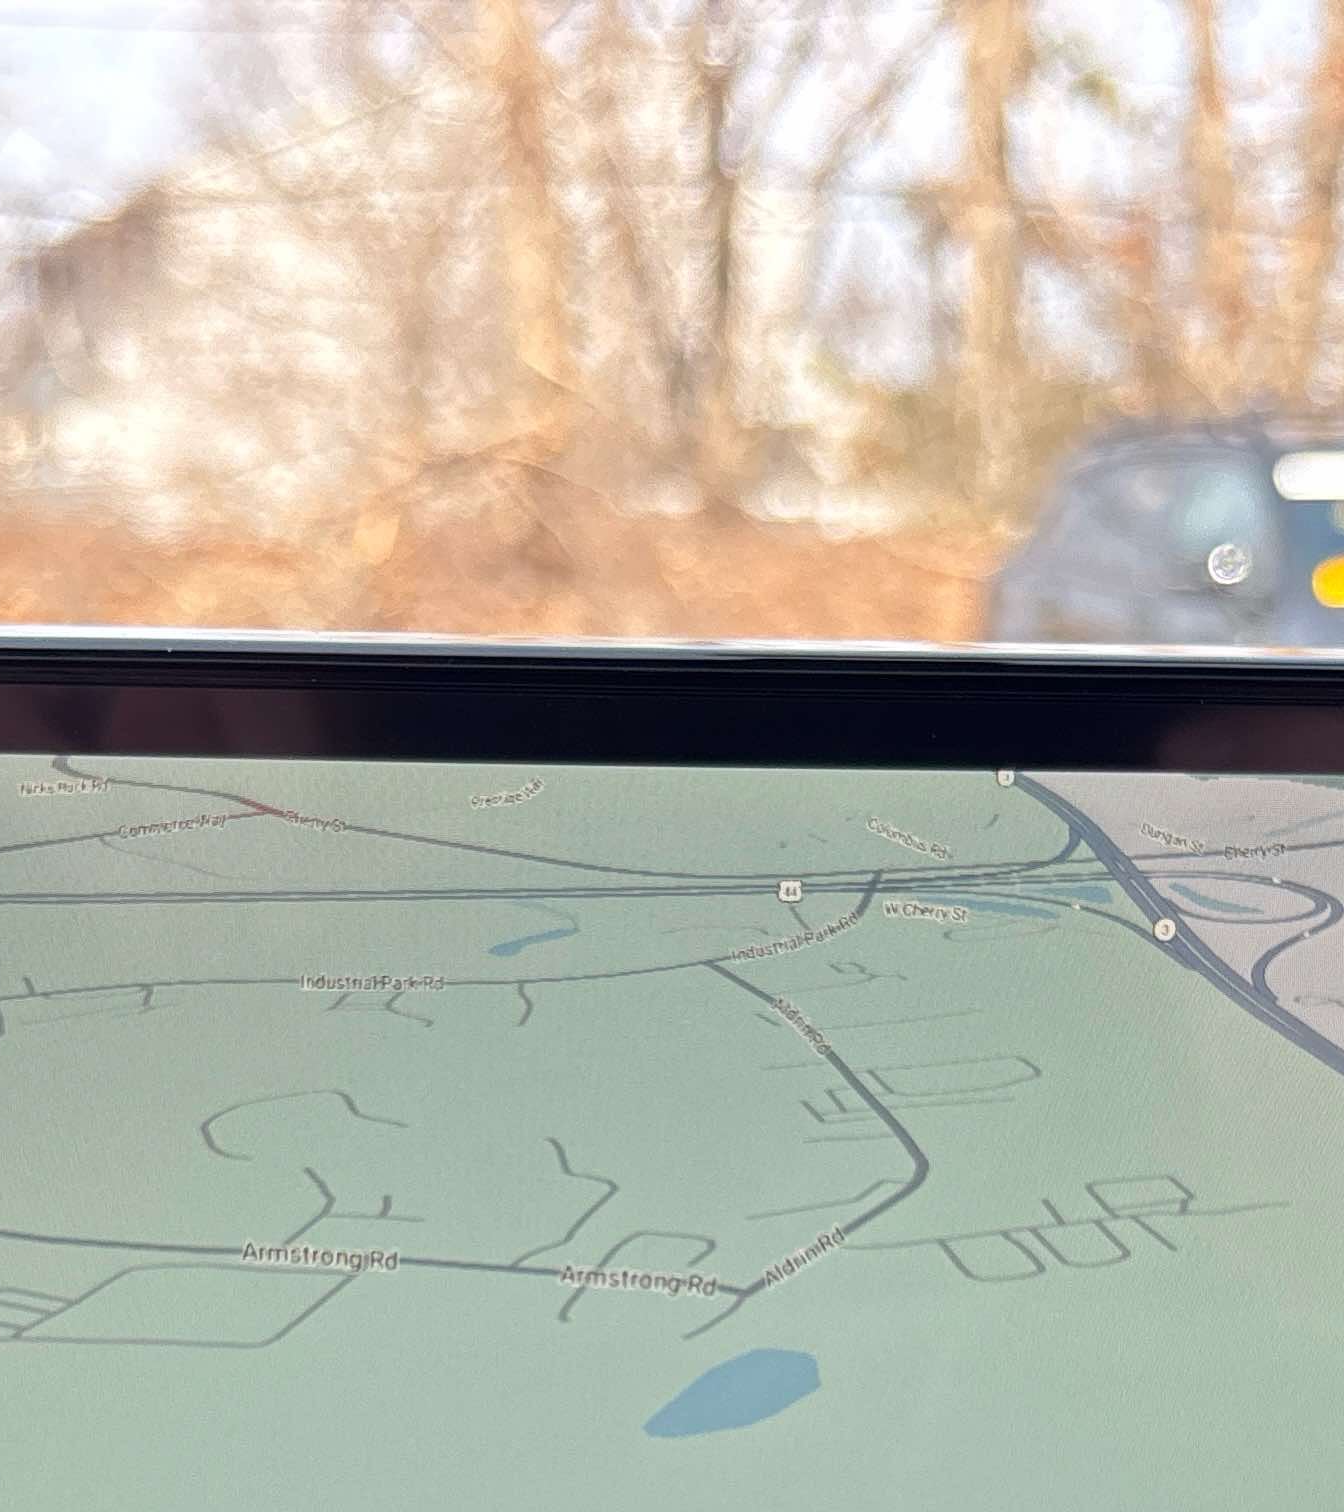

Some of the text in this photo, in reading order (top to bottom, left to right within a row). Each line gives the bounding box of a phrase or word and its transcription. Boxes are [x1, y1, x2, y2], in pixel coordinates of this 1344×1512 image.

[902, 902, 949, 919] Cherry
[951, 907, 967, 921] St
[300, 974, 445, 991] Industrial Park Rd
[242, 1241, 399, 1271] Armstrong Rd
[764, 1227, 846, 1287] Aldrin Rd
[561, 1264, 718, 1297] Armstrong Rd
